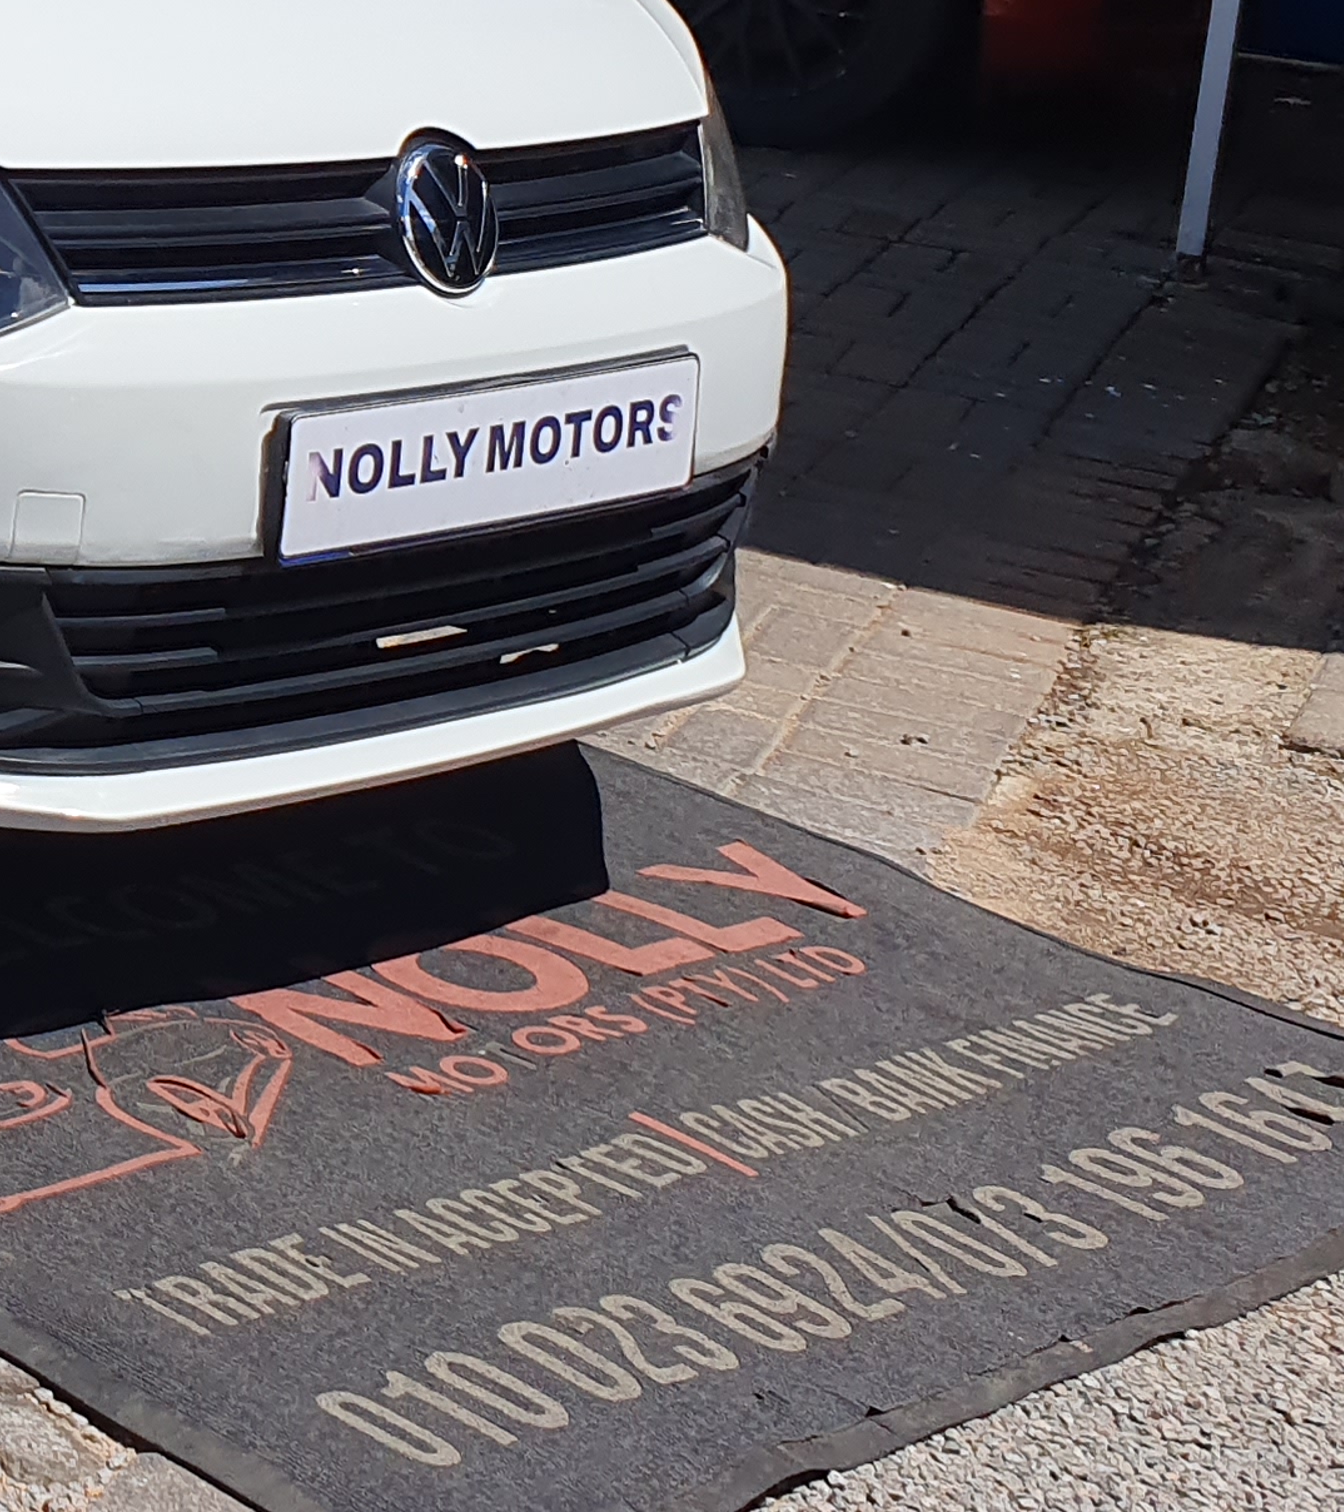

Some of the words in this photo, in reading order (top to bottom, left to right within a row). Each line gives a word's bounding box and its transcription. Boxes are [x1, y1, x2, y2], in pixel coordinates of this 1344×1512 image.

[305, 427, 479, 501] NOLLY
[485, 394, 683, 473] MOTORS
[212, 839, 867, 1066] NOLLY
[113, 1233, 372, 1336] TRADE
[319, 1219, 442, 1275] IN
[395, 1132, 708, 1256] ACCEPTED
[947, 992, 1179, 1079] FINANCE
[316, 1351, 570, 1467] 010
[497, 1294, 741, 1403] 023
[1040, 1127, 1245, 1222] 196
